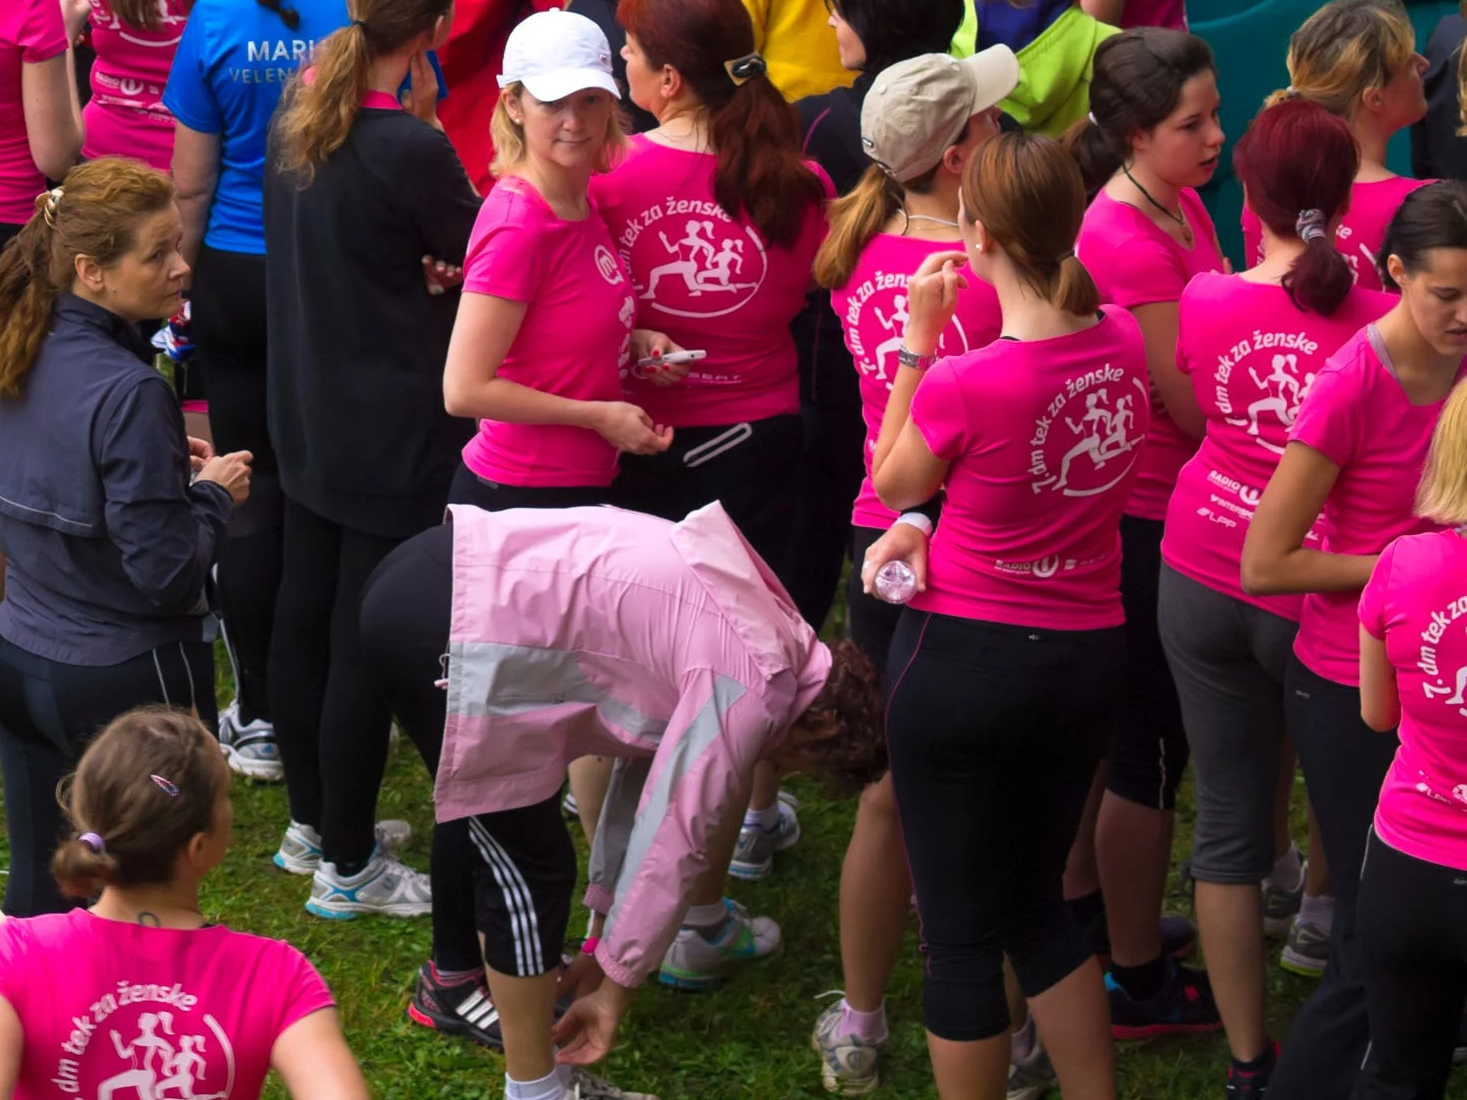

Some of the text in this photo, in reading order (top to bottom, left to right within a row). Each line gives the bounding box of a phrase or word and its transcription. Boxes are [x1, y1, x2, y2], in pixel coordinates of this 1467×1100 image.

[229, 67, 292, 84] VELEN
[619, 219, 644, 248] tek
[640, 204, 663, 226] za
[846, 296, 862, 326] tek
[856, 281, 875, 303] za
[1230, 339, 1252, 362] za
[1253, 329, 1318, 355] ženske
[1065, 363, 1125, 399] ženske
[1214, 355, 1235, 384] tek
[1047, 393, 1066, 418] za
[1214, 385, 1233, 414] dm
[1030, 415, 1052, 446] tek
[1027, 449, 1048, 475] dm
[1209, 470, 1241, 491] RADIO
[1208, 512, 1237, 528] LPP
[1421, 611, 1451, 644] tek
[1416, 645, 1439, 676] dm
[51, 980, 198, 1093] dm tek za ženske
